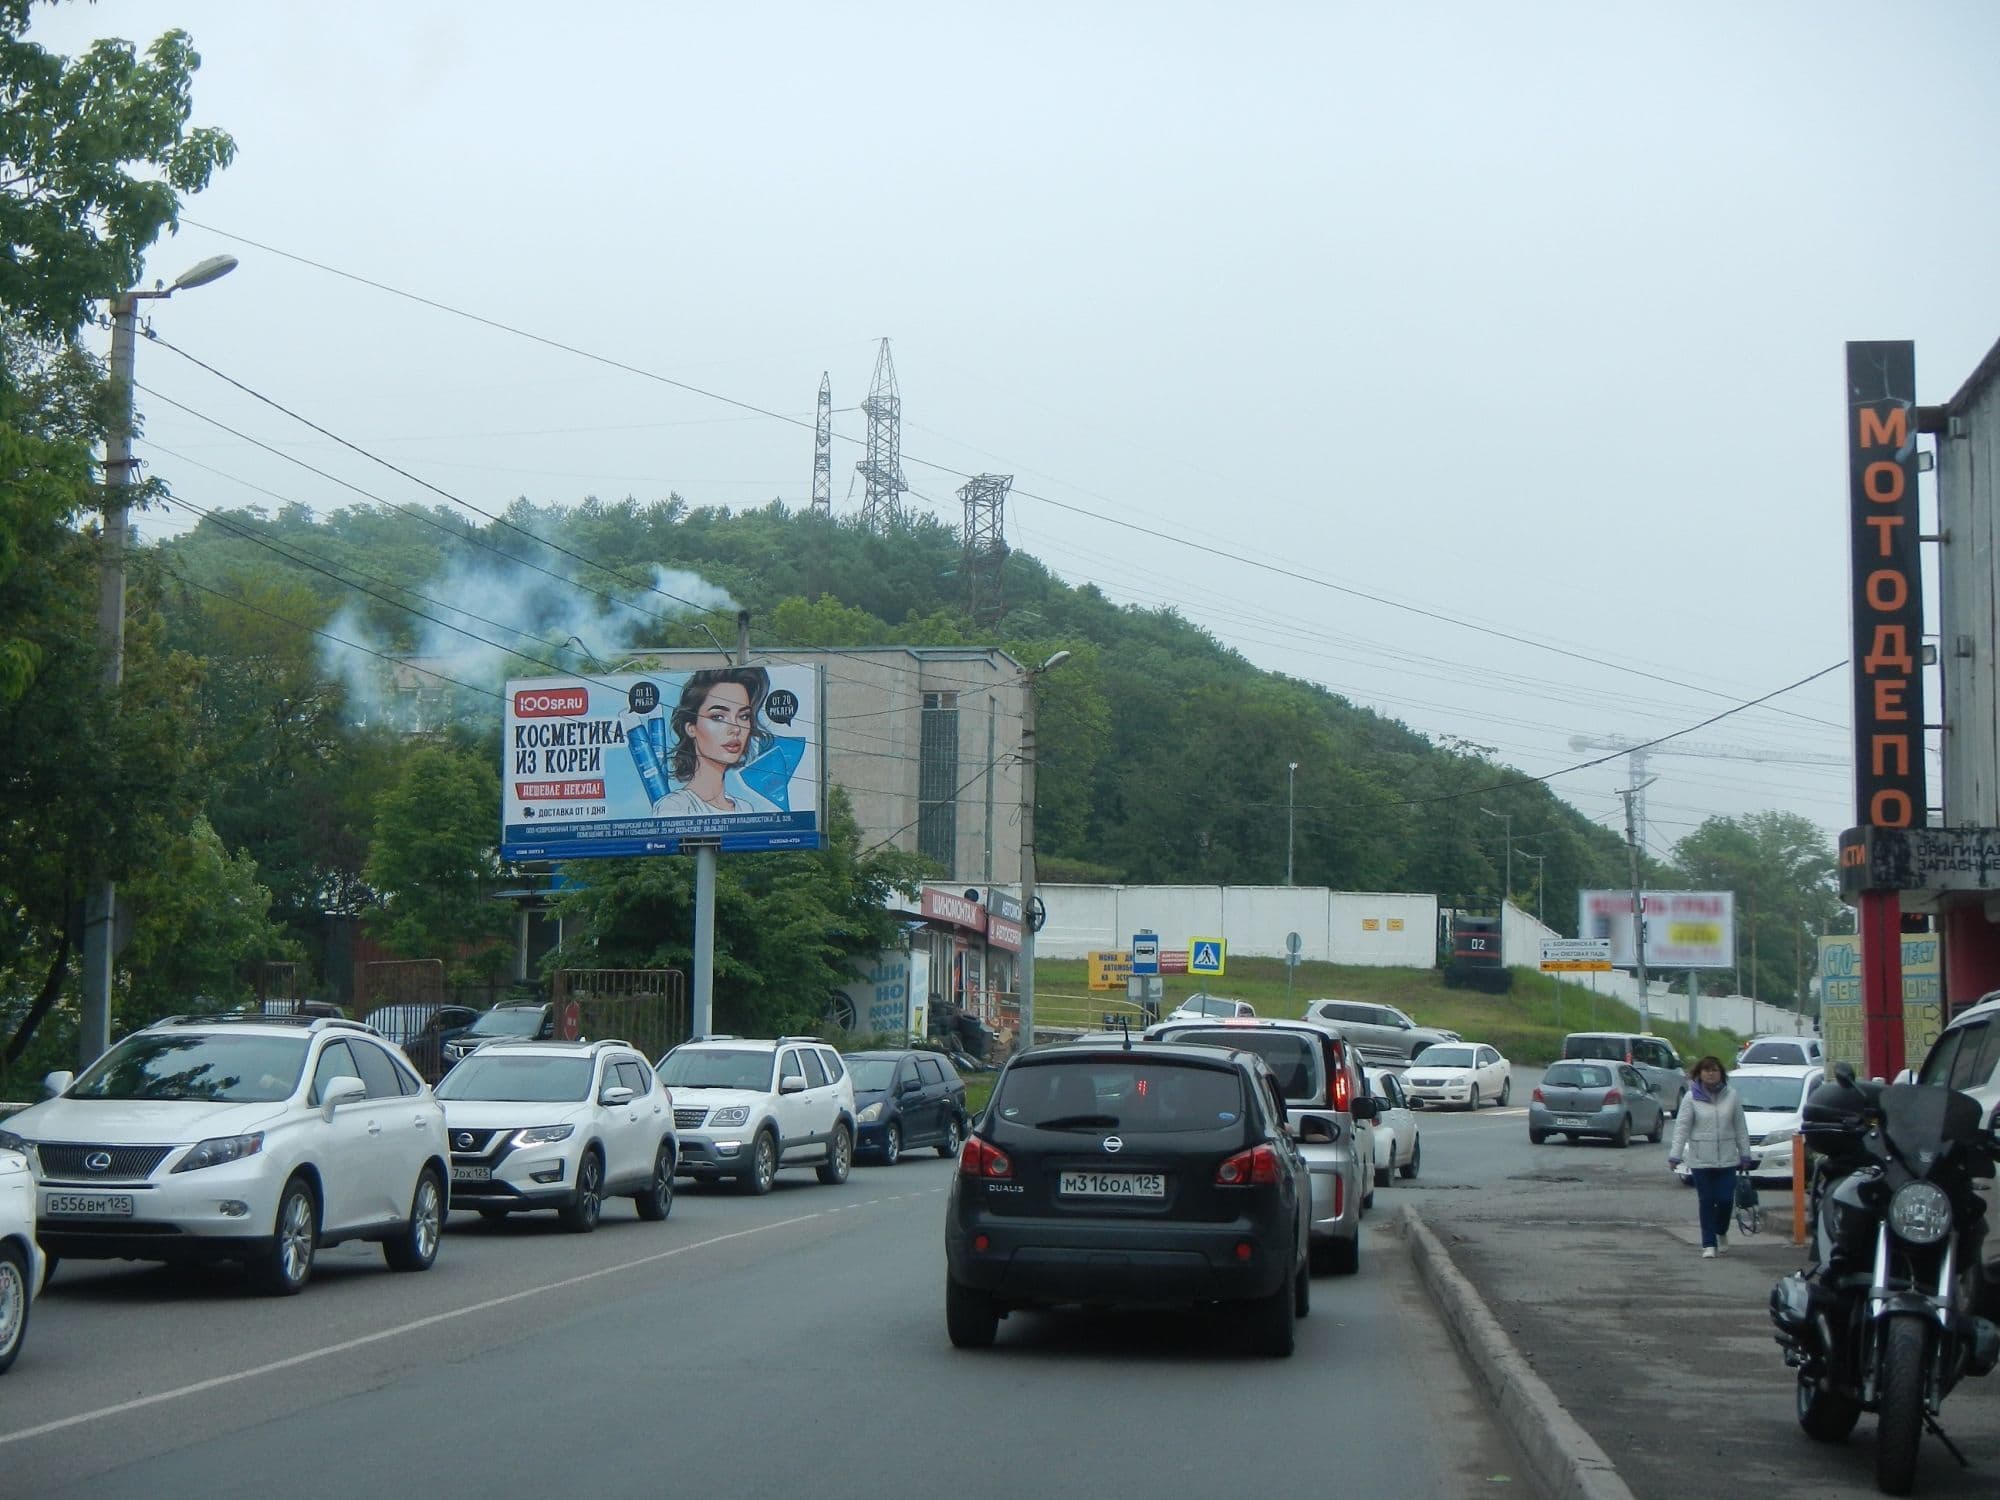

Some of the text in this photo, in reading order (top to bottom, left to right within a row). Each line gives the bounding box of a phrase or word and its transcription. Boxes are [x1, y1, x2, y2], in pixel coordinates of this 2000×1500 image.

[1859, 407, 1913, 828] МОТОДЕПО
[520, 696, 583, 711] 100SP.RU
[772, 695, 791, 706] ОТ 20
[769, 704, 794, 716] РУБЛЕЙ
[515, 720, 625, 748] КОСМЕТИКА
[516, 746, 601, 775] ИЗ КОРЕИ
[523, 782, 600, 797] ДЕШЕВЛЕ НЕКУДА!
[538, 806, 574, 818] ДОСТАВКА
[575, 806, 583, 816] ОТ
[591, 805, 606, 817] ДНЯ
[932, 893, 977, 925] ШИНОМОНТАЖ
[1471, 938, 1485, 950] 02
[474, 1168, 489, 1177] 125
[988, 1184, 1024, 1193] DUALIS
[1065, 1175, 1160, 1193] М316ОА 125
[51, 1197, 128, 1212] В556ВМ 125
